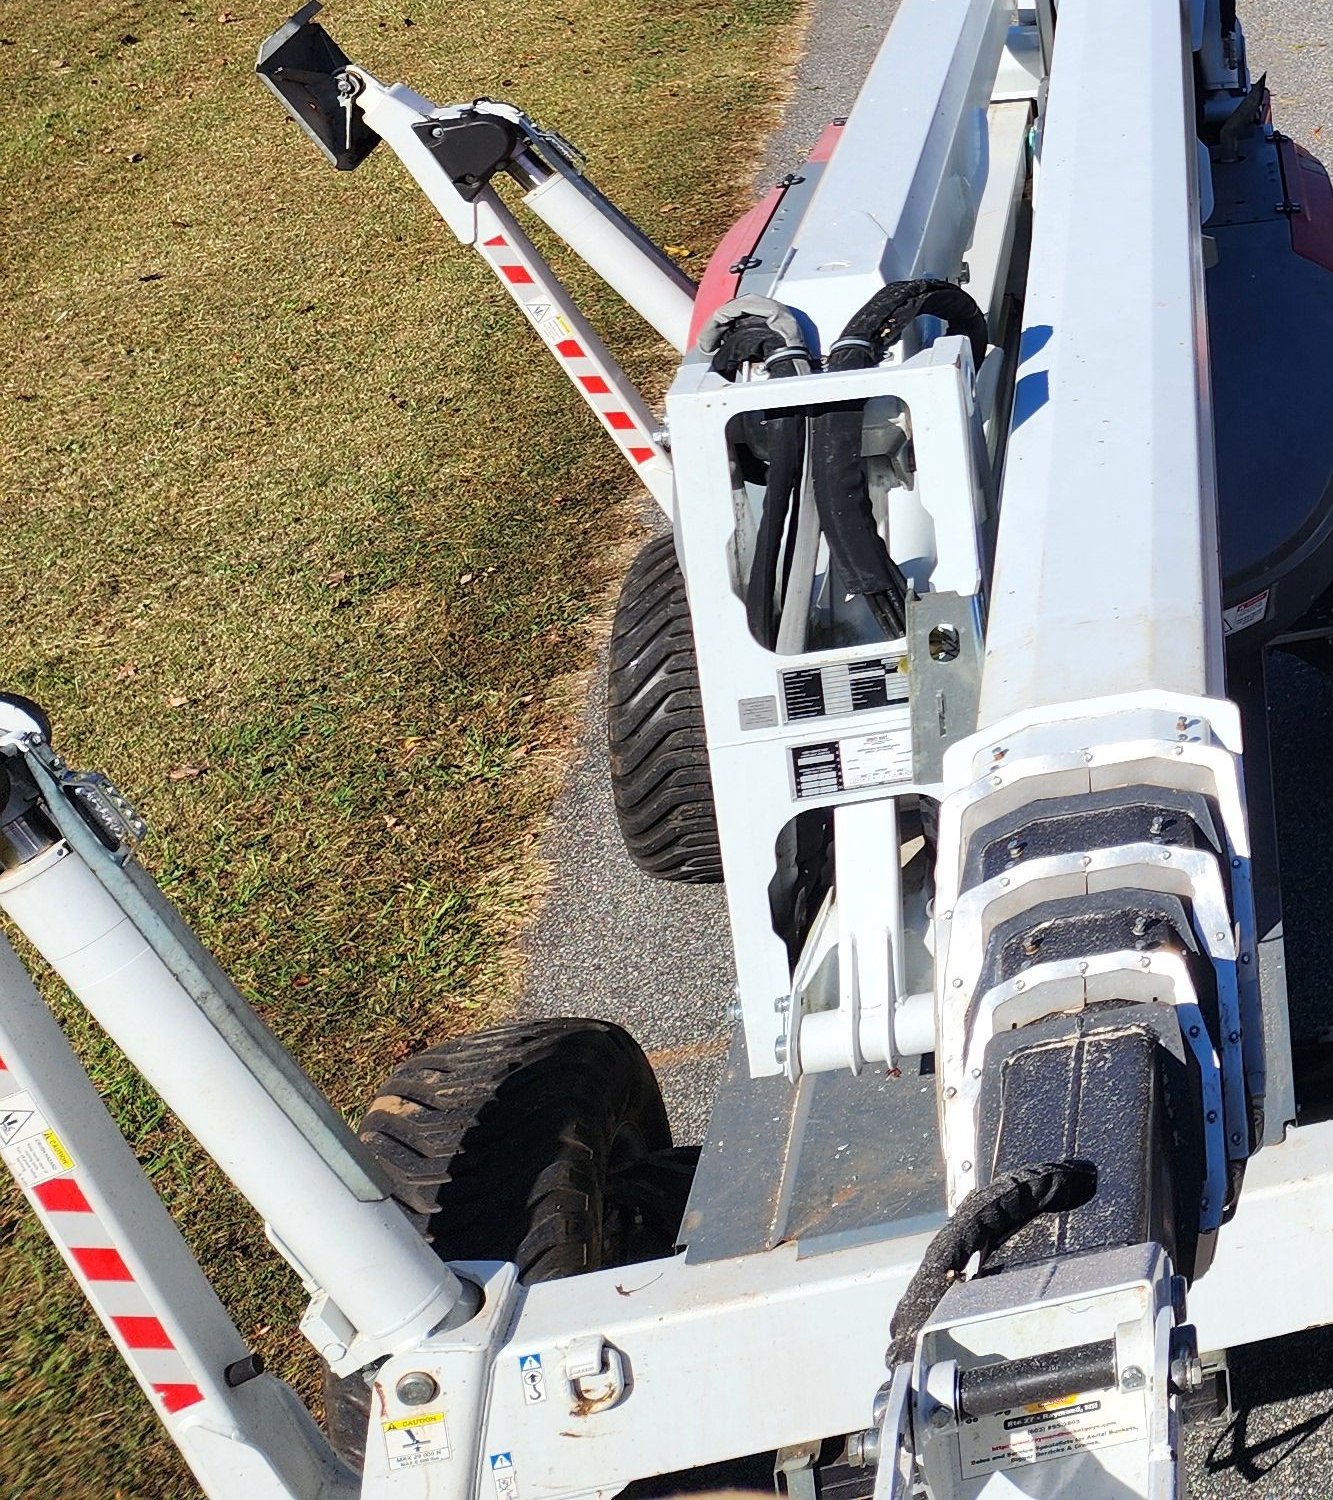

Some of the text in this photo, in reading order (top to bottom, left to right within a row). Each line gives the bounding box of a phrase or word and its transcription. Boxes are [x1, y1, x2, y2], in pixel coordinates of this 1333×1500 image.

[49, 1139, 69, 1165] CAUTION
[1042, 1404, 1084, 1420] Raymond,
[402, 1416, 437, 1428] CAUTION
